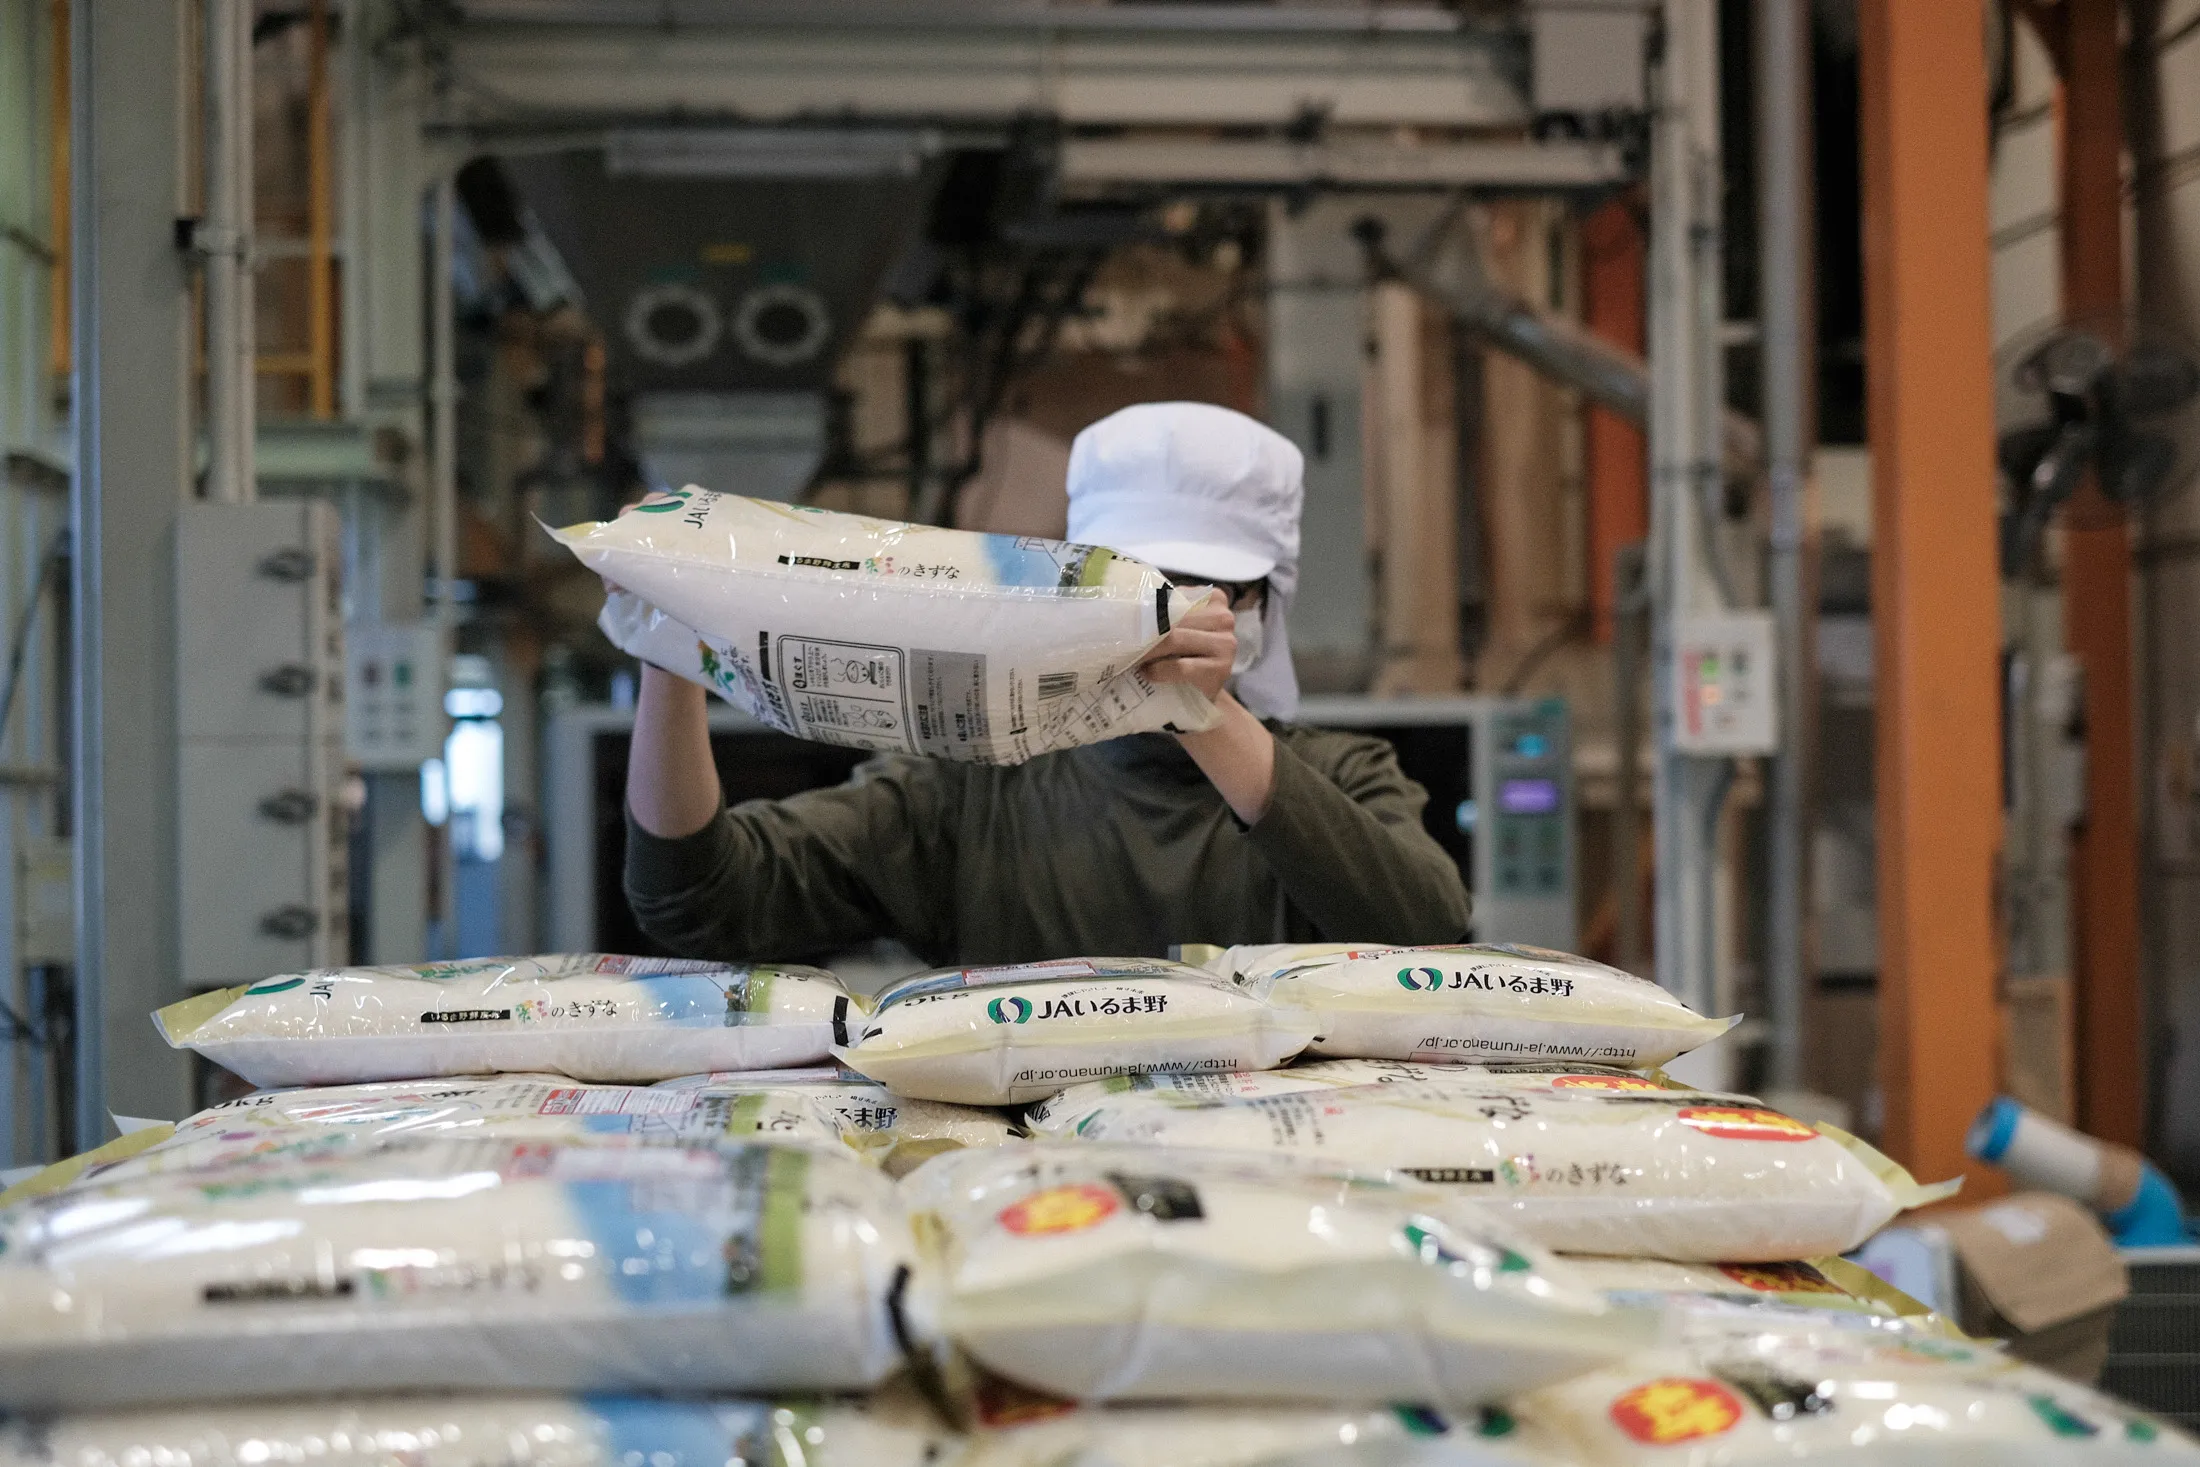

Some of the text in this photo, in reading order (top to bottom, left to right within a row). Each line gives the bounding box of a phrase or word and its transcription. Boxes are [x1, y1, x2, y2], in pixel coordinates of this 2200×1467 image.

[1448, 971, 1575, 997] JAいるま野
[1037, 994, 1168, 1020] JAいるま野
[1416, 1037, 1637, 1058] http://www.ja-irumano.or.jp/
[1012, 1058, 1238, 1083] http://www.ja-irumano.or.jp/
